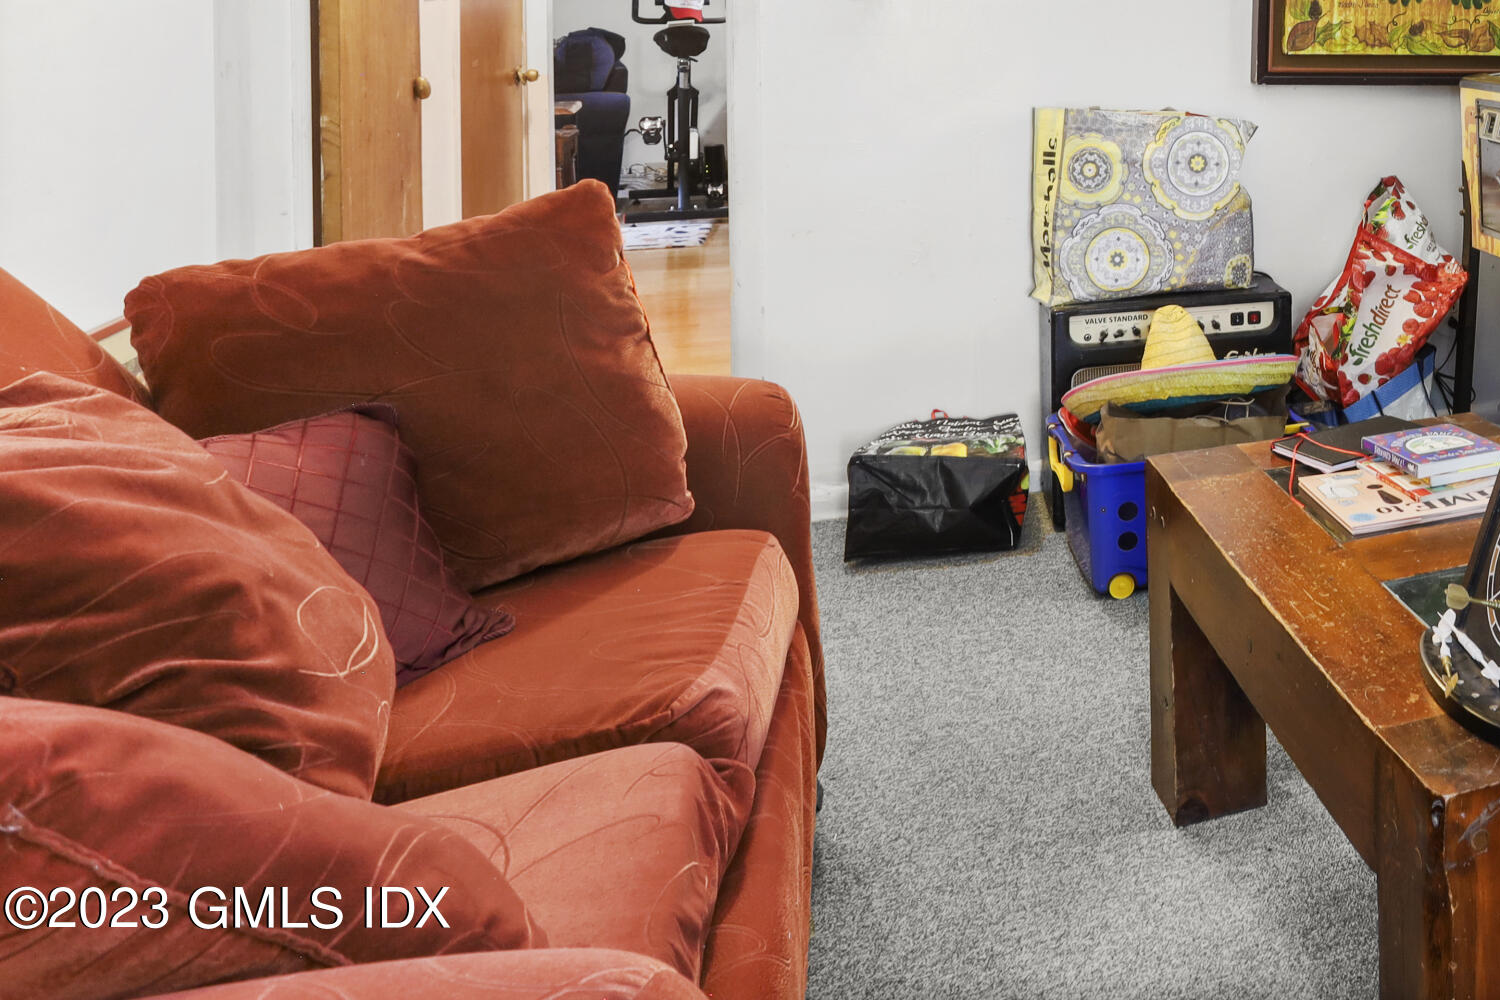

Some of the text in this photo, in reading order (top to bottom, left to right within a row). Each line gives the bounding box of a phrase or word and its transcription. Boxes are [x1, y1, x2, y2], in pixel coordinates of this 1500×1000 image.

[1085, 314, 1149, 325] VALVE STANDARD
[1349, 284, 1401, 360] freshdirect
